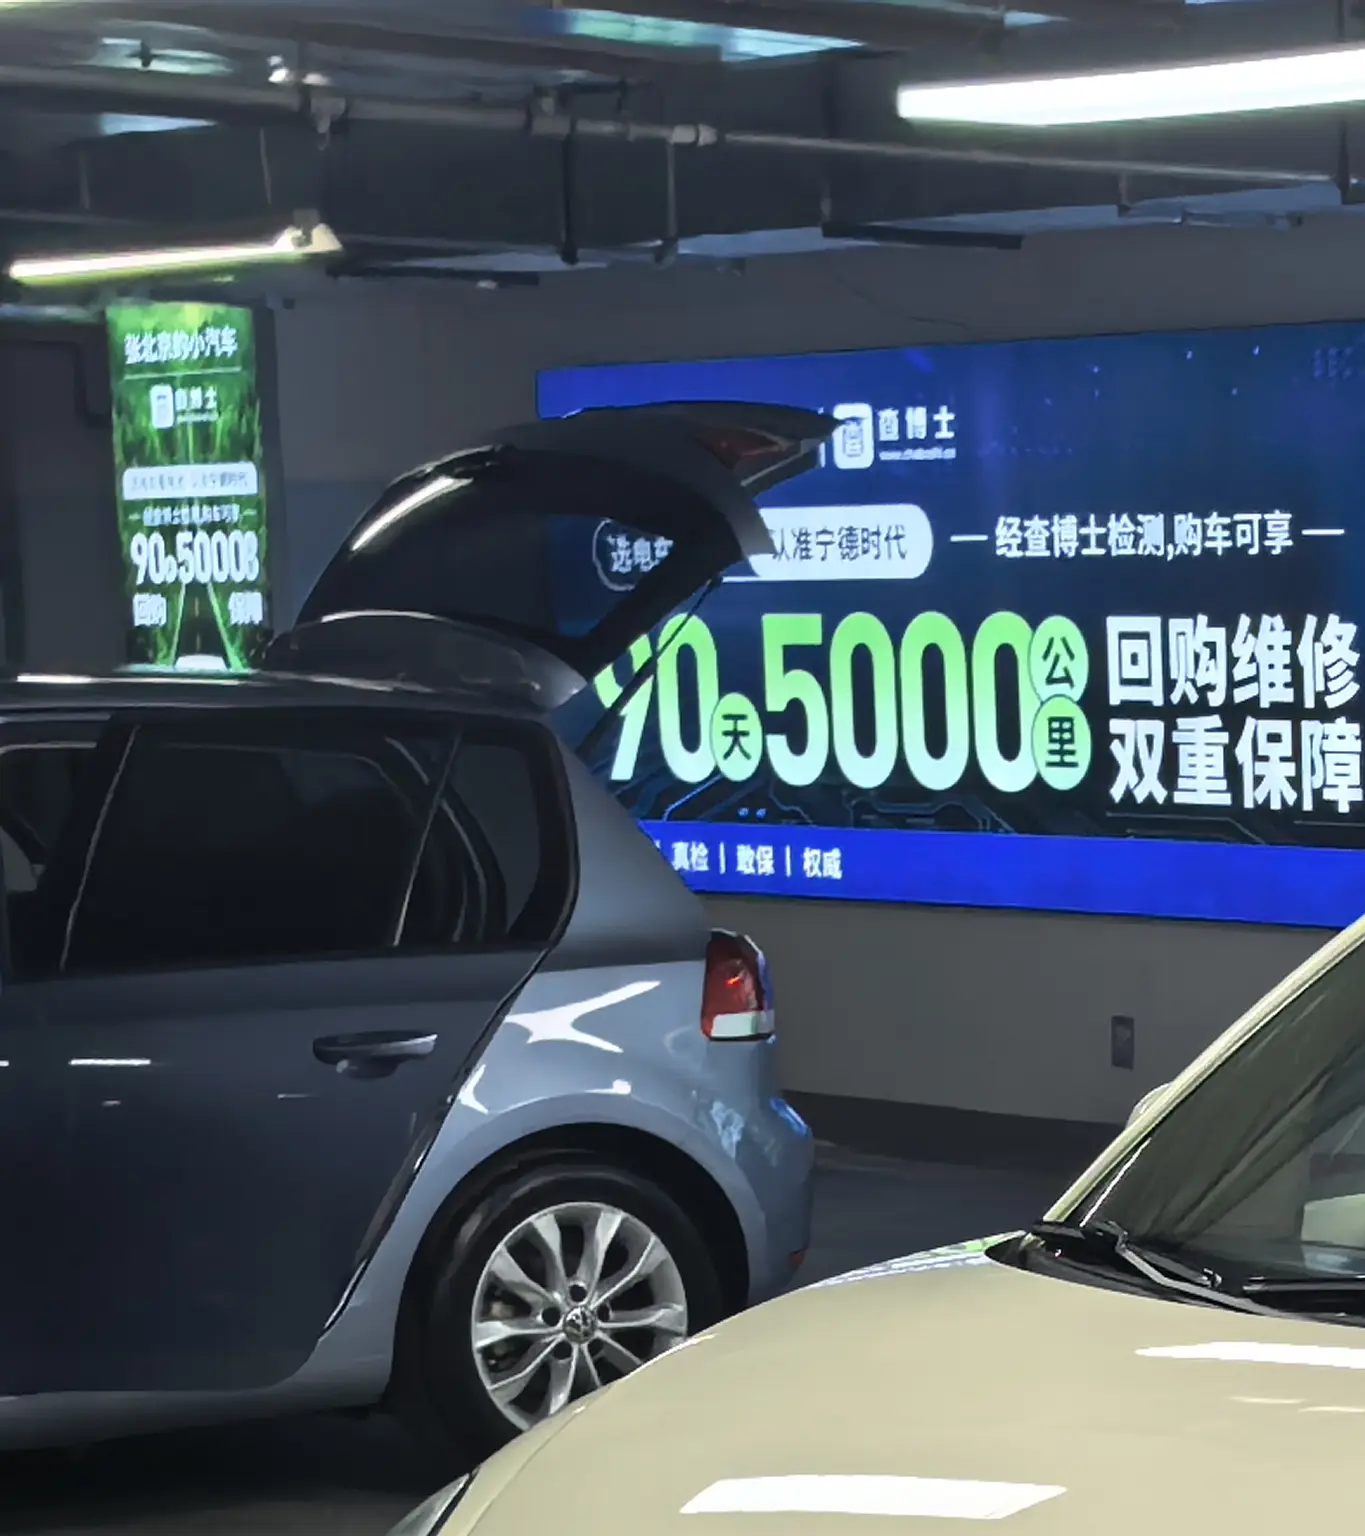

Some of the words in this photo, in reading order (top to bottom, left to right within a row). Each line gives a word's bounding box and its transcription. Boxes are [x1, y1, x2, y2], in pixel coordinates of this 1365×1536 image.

[994, 511, 1296, 561] 经查博士检测,购车可享
[1105, 613, 1362, 712] 回购维修
[1109, 714, 1365, 814] 双重保障
